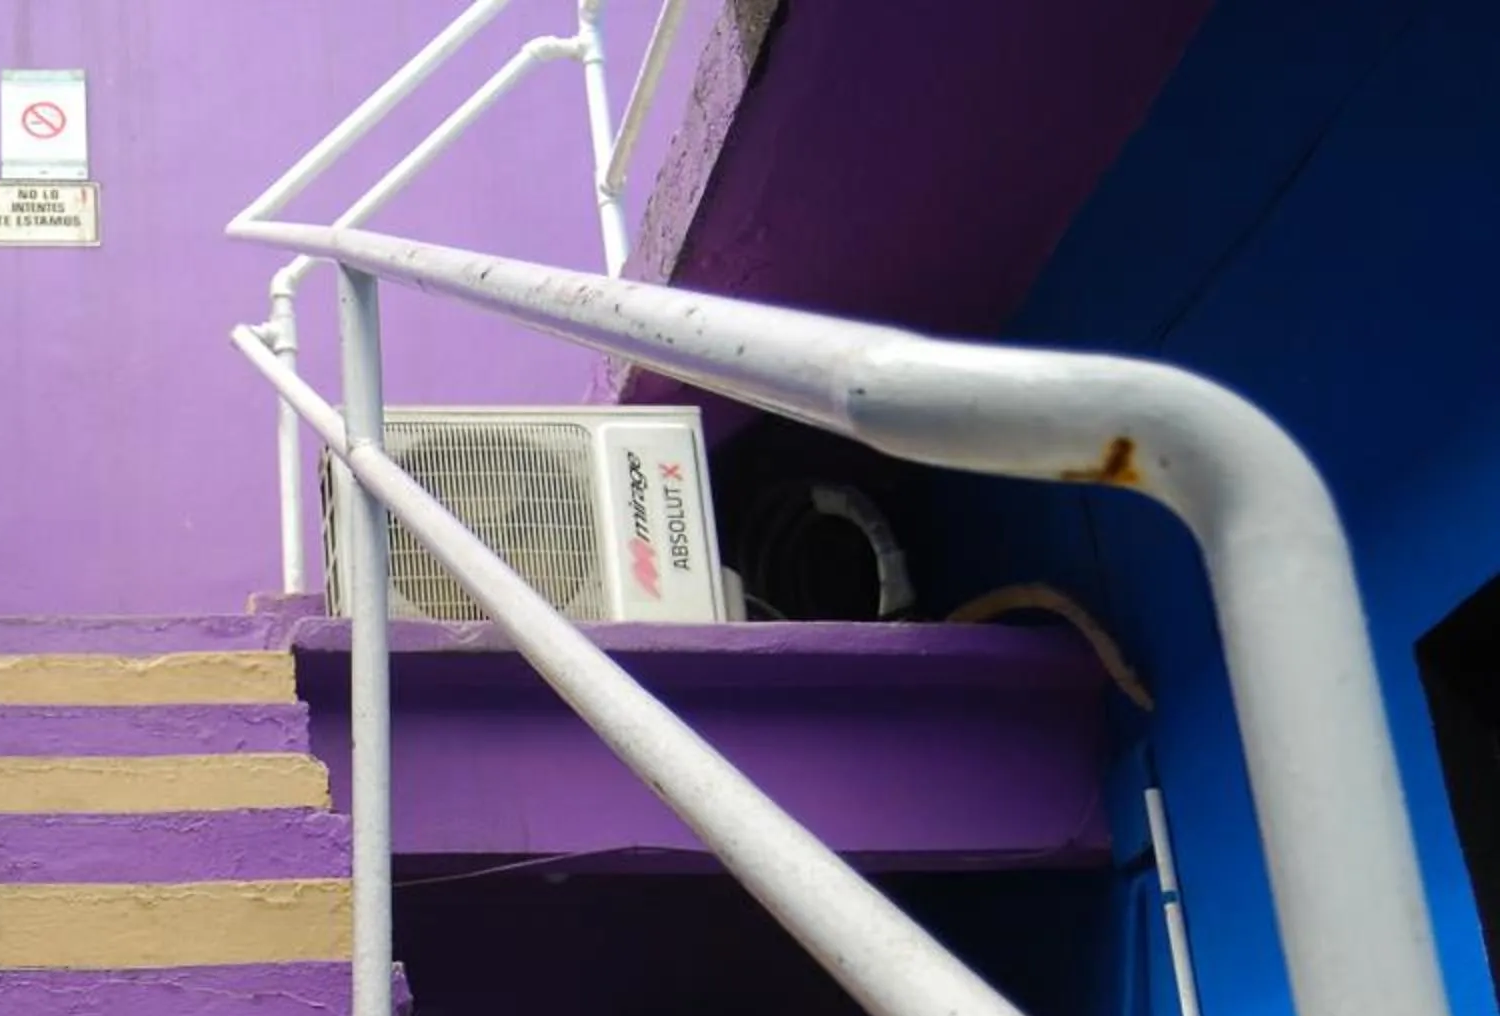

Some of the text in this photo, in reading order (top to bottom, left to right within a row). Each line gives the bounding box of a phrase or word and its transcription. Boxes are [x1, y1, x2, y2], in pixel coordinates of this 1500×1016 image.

[17, 189, 59, 200] NO LO
[11, 201, 65, 213] INTENTES
[16, 215, 81, 227] ESTAMOS
[626, 451, 652, 543] mirage
[658, 462, 691, 571] ABSOLUT X
